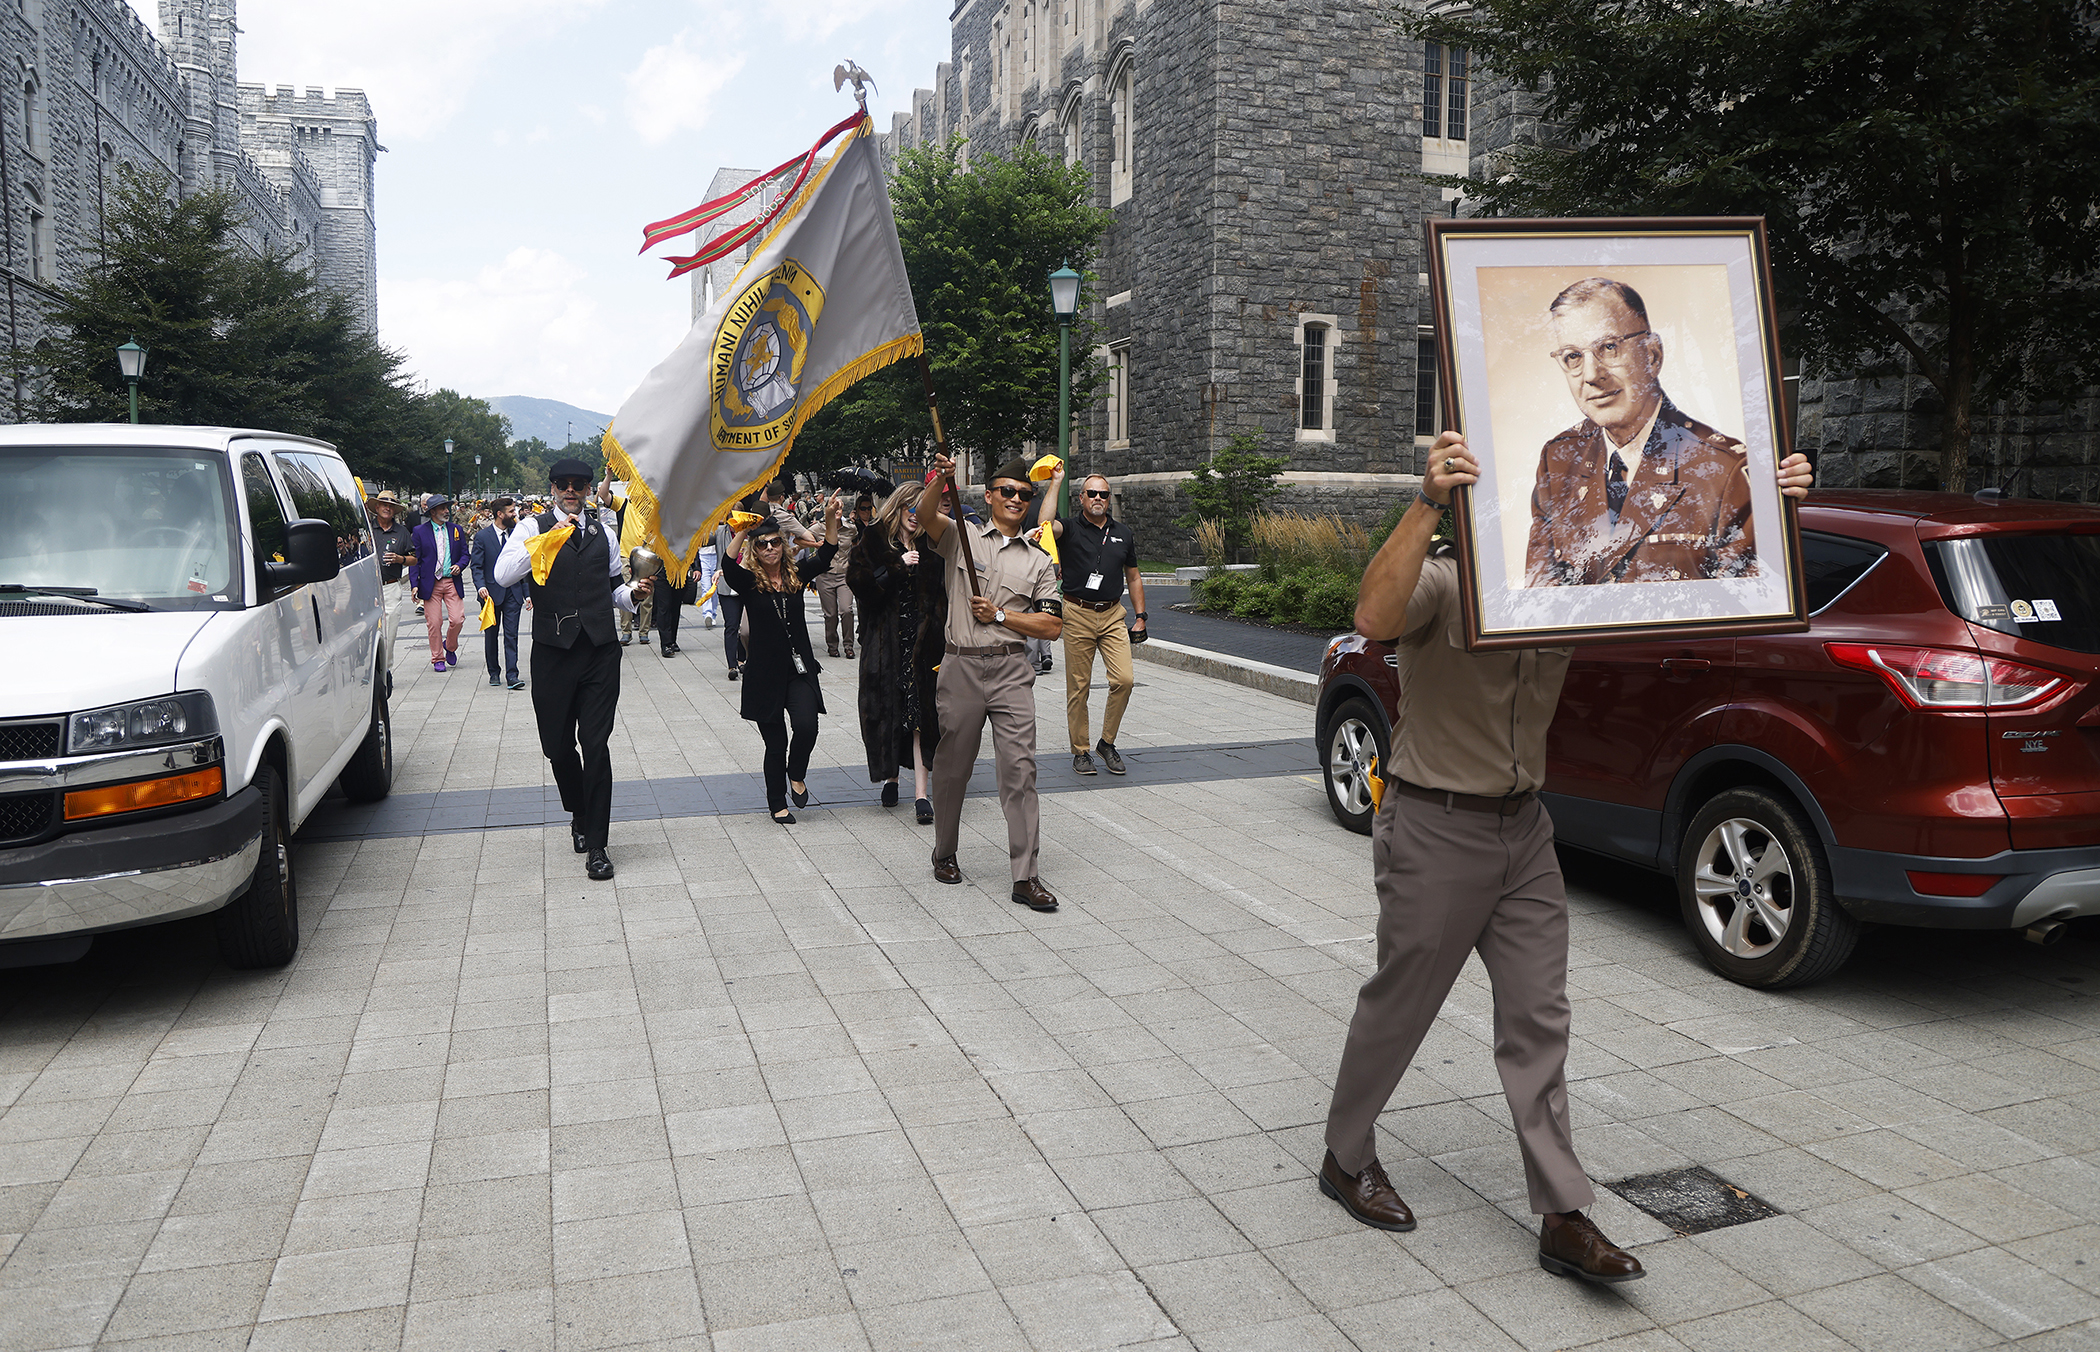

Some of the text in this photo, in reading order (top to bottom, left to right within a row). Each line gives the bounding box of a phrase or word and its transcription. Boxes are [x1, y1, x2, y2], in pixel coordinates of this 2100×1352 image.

[714, 286, 767, 402] HUMANI NIHIL
[764, 425, 779, 441] OF
